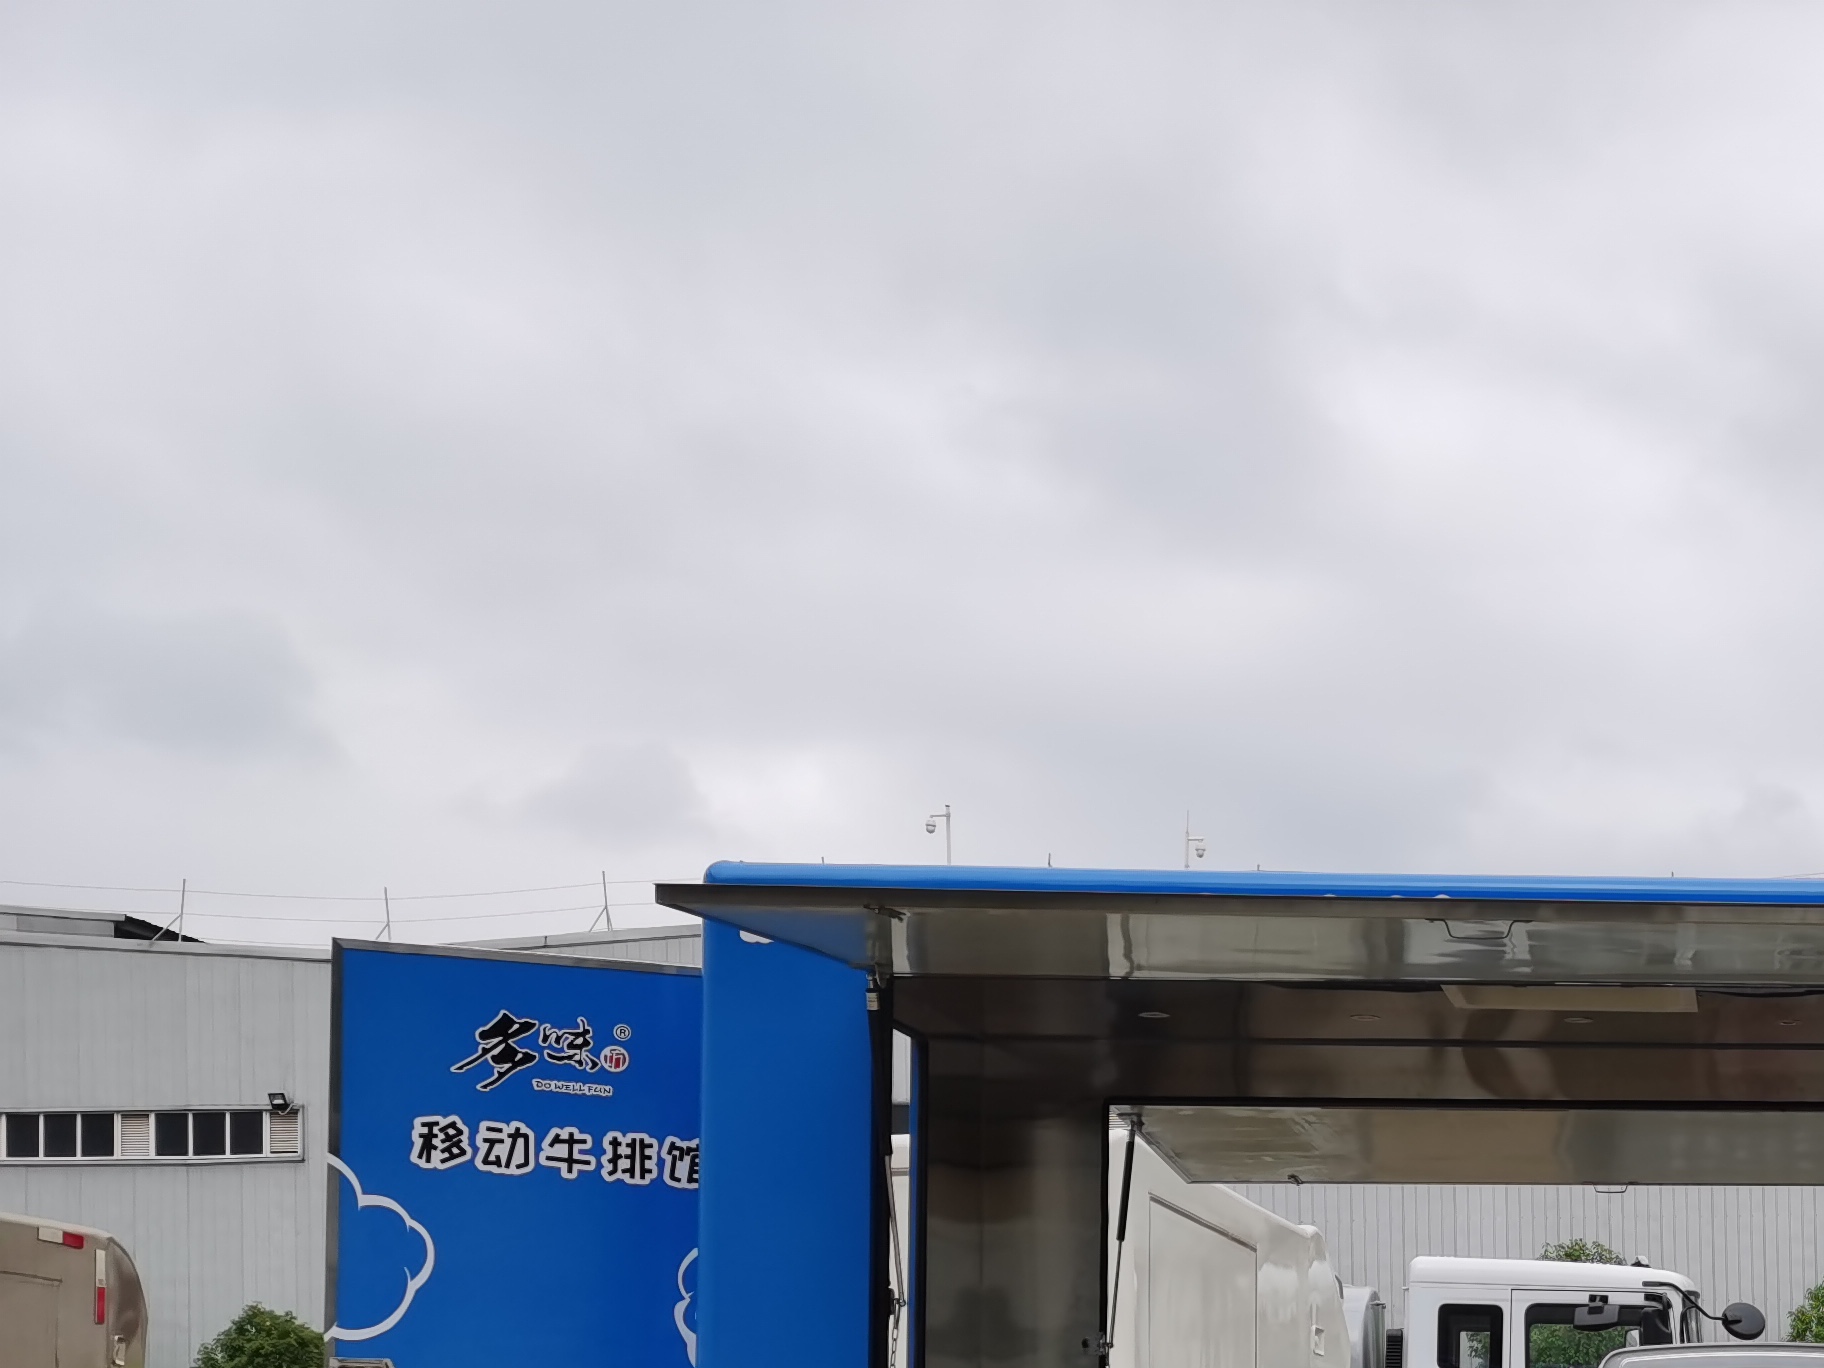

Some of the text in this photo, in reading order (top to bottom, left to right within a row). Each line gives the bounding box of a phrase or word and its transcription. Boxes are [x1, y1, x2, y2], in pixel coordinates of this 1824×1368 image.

[534, 1080, 612, 1095] DO WELL FUN
[414, 1118, 698, 1186] 移动牛排馆
